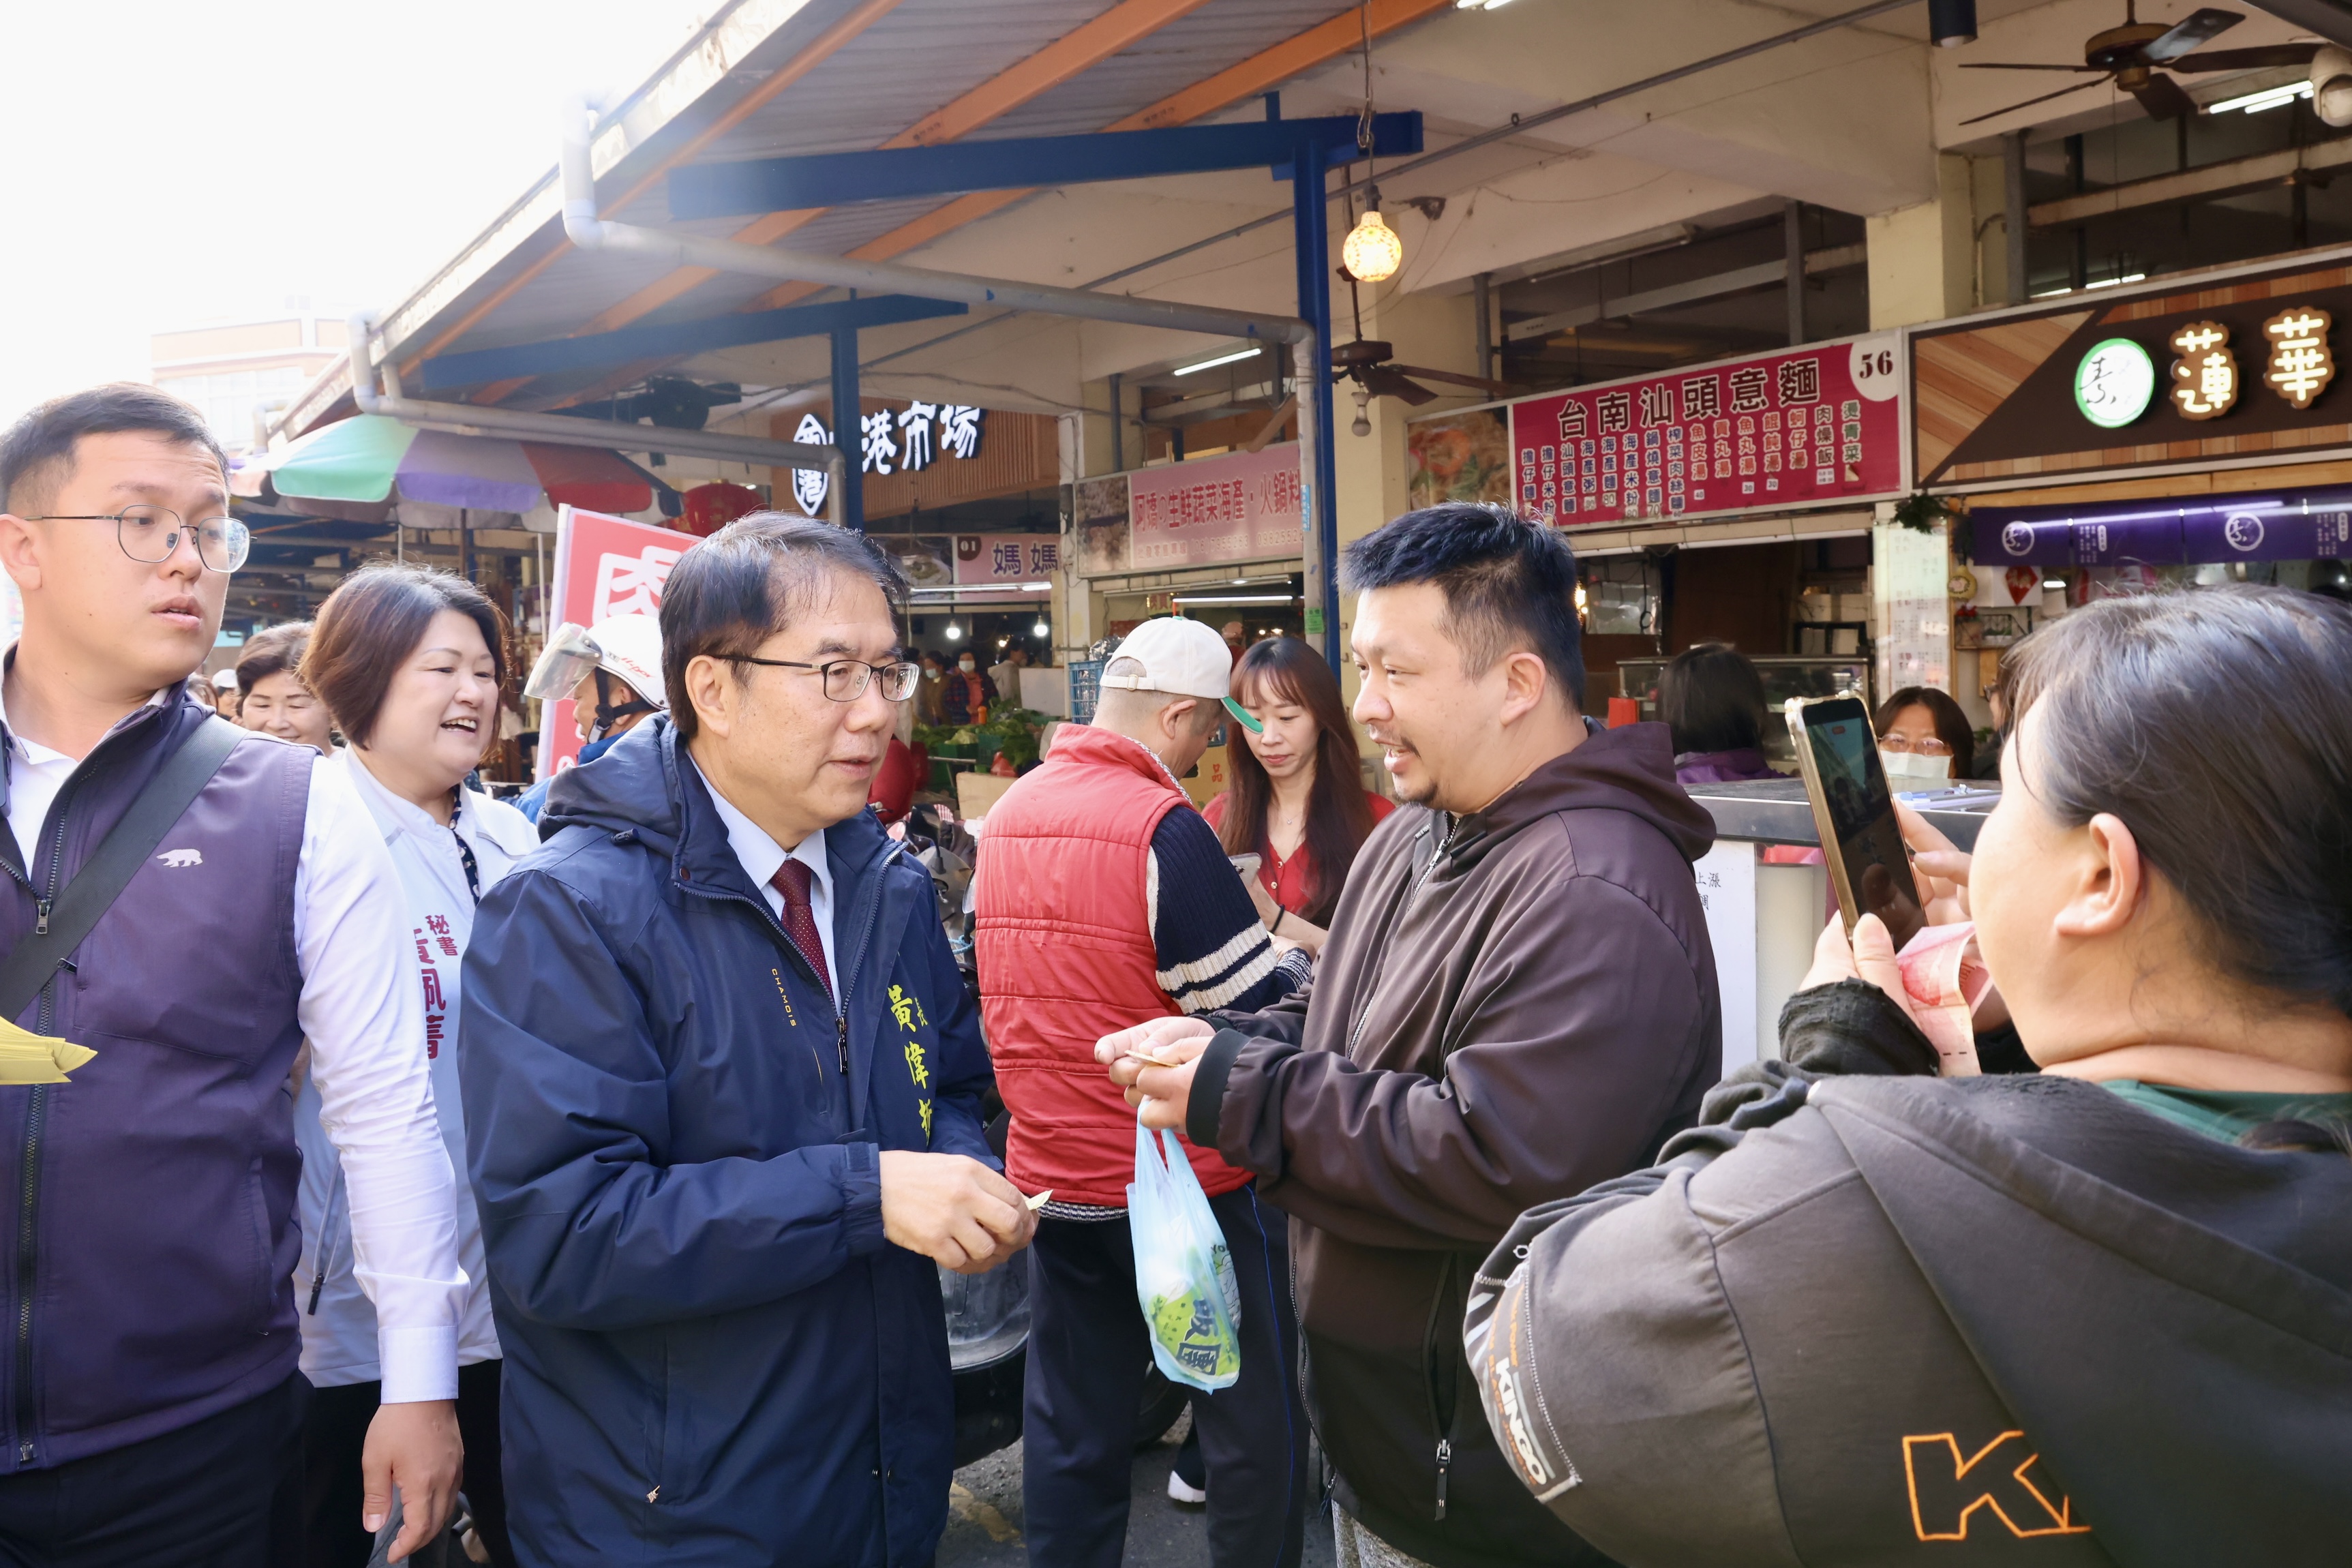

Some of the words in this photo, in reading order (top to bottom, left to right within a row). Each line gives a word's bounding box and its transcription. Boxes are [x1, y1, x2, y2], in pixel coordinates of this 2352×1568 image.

[1858, 350, 1894, 380] 56
[1557, 357, 1820, 441] 台南汕頭意麵
[1689, 423, 1707, 481] 魚皮湯
[1738, 416, 1756, 476] 魚丸湯
[1815, 404, 1835, 466] 肉燥飯
[1603, 493, 1616, 505] 80
[959, 541, 977, 552] 01
[425, 914, 458, 956] 秘書
[772, 968, 796, 1027] CHAMOIS
[1496, 1357, 1547, 1485] KINGO
